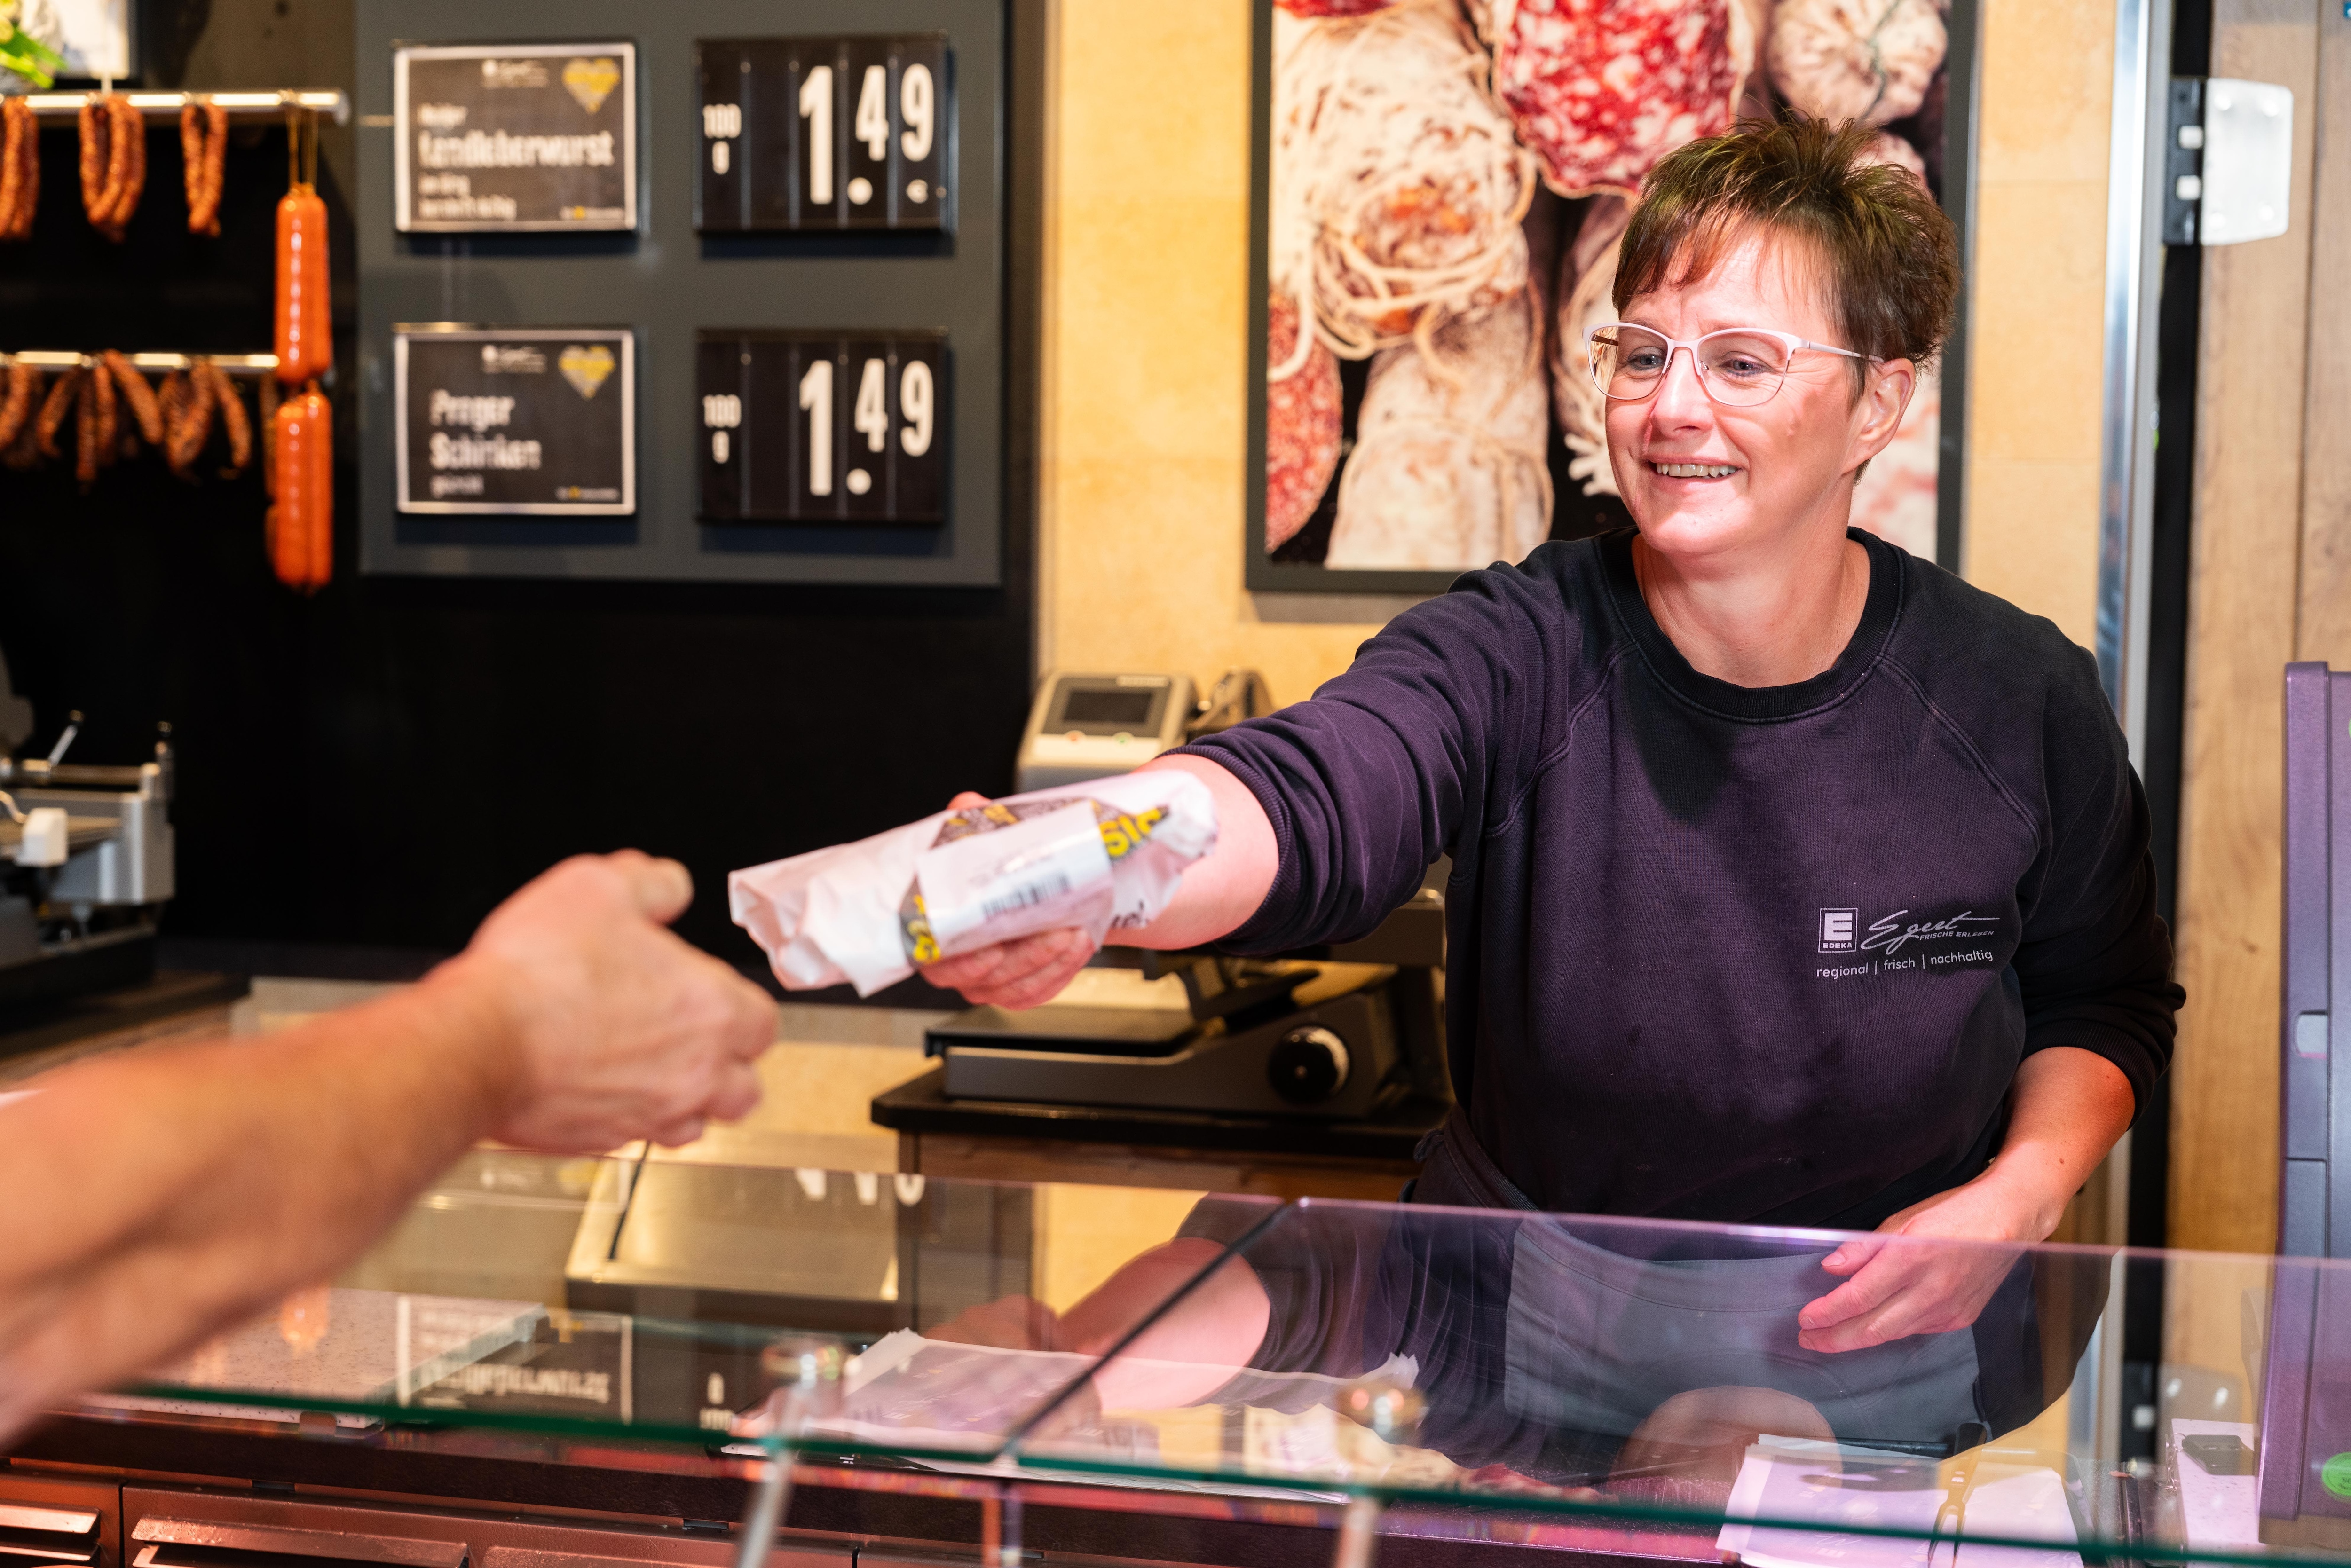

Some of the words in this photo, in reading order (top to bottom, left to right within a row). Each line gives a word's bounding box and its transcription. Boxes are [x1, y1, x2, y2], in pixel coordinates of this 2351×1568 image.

[702, 103, 742, 138] 100
[702, 394, 742, 428] 100
[1919, 931, 1954, 941] FRISCHE
[1816, 963, 1869, 980] regional
[1884, 958, 1915, 970] frisch
[1930, 950, 1993, 965] nachhaltig
